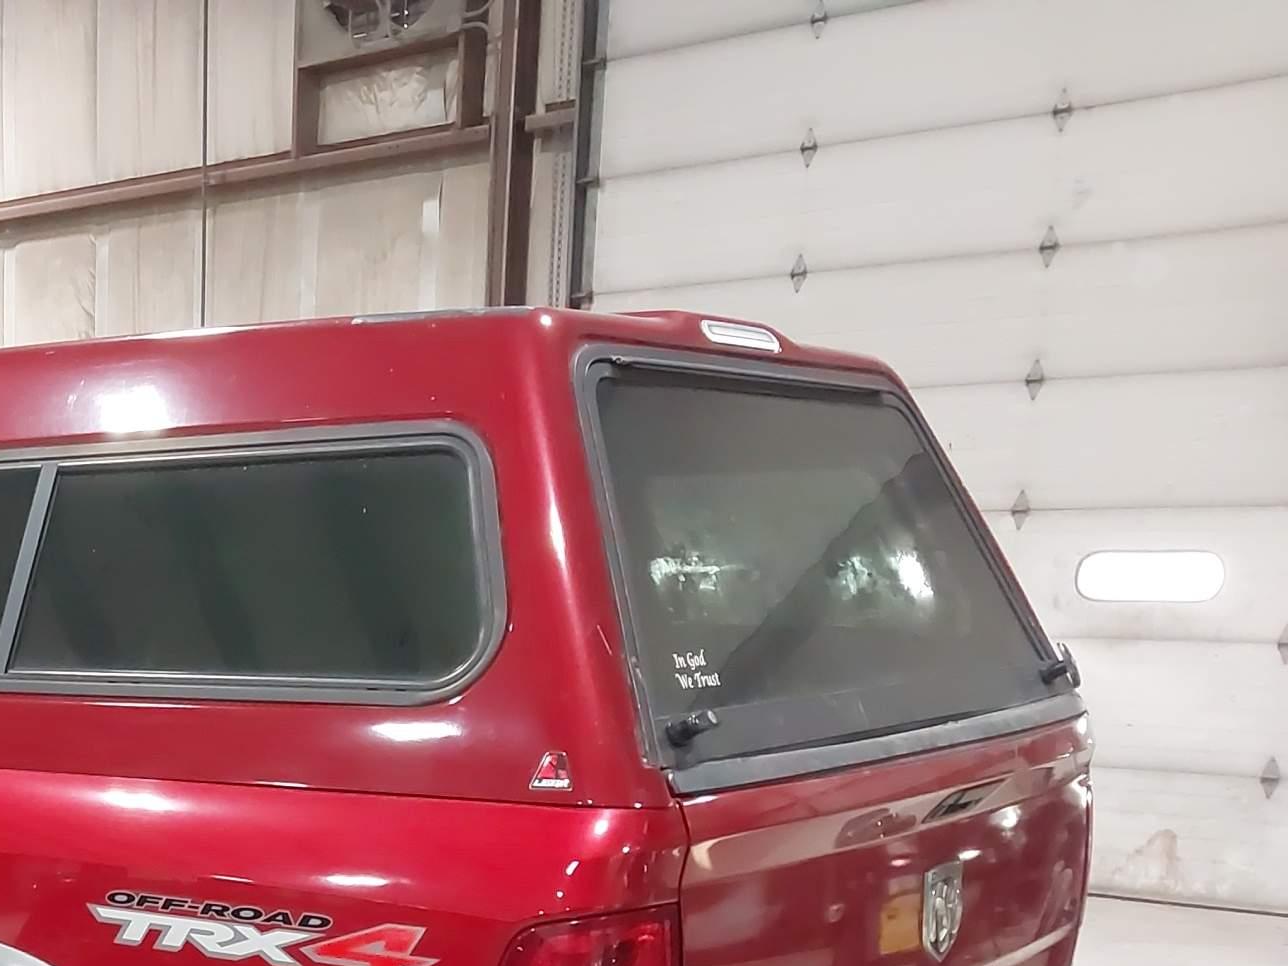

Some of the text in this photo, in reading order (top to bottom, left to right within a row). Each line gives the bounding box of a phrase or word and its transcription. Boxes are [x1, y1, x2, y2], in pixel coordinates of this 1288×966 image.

[672, 648, 707, 671] In God
[674, 670, 721, 689] We Trust
[105, 891, 334, 930] OFF-ROAD
